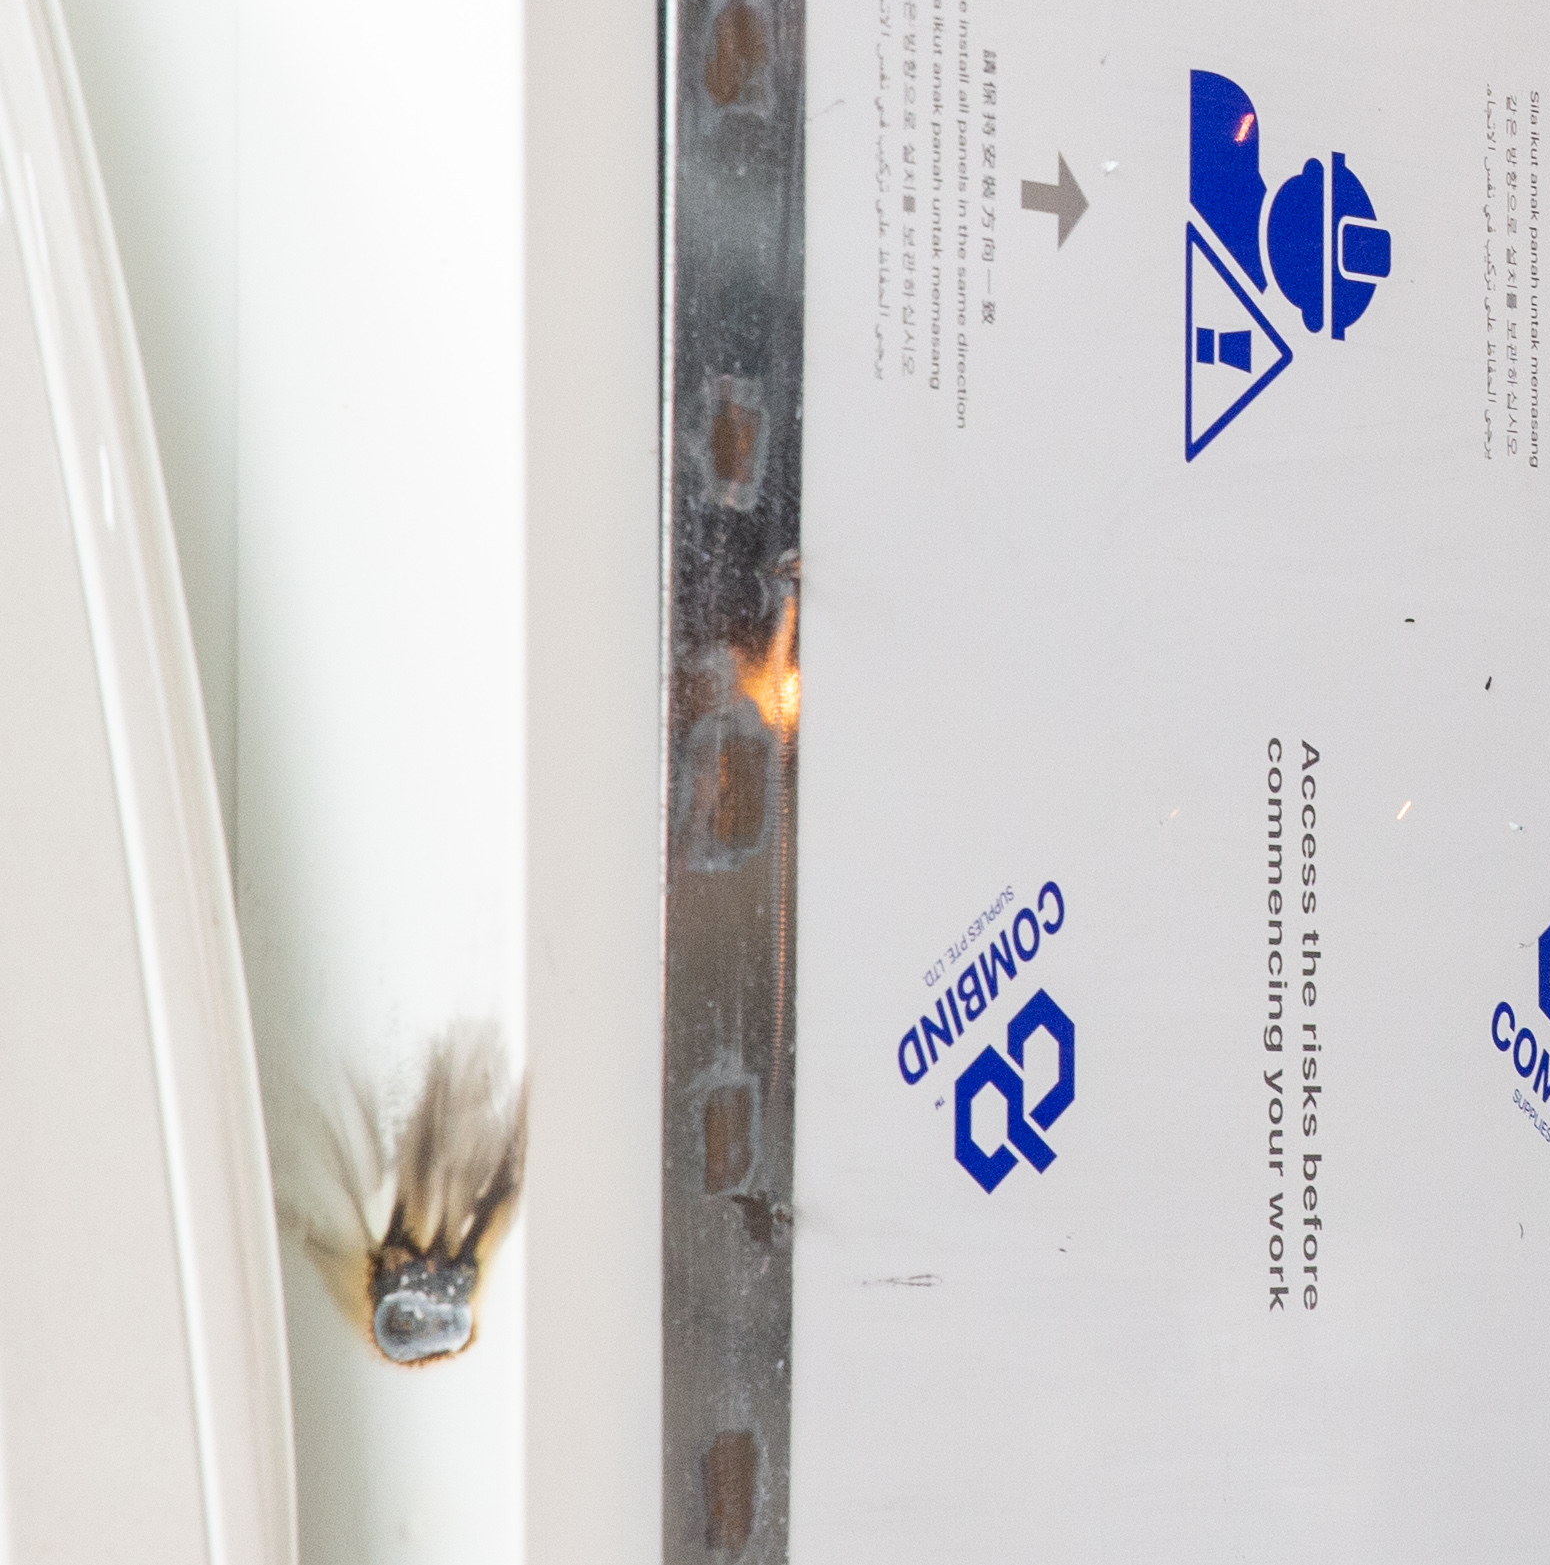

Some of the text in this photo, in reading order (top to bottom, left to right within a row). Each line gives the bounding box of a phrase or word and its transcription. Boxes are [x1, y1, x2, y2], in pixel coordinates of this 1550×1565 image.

[933, 16, 944, 55] ikut
[959, 19, 970, 84] install
[933, 62, 944, 114] anak
[958, 89, 970, 114] all
[1530, 91, 1540, 125] Sila
[930, 121, 943, 191] panah
[956, 119, 969, 192] panels
[1530, 131, 1540, 167] ikut
[958, 199, 968, 218] in
[1530, 173, 1540, 220] anak
[958, 225, 969, 260] the
[1528, 226, 1540, 289] panah
[957, 267, 966, 326] same
[929, 266, 940, 390] memasang
[957, 332, 968, 429] direction
[1529, 356, 1539, 468] memasang
[967, 885, 1014, 942] SUPPLIES
[897, 881, 1066, 1086] COMBIND
[1263, 737, 1290, 1312] commencing your work
[1301, 739, 1323, 1311] Access the risks before
